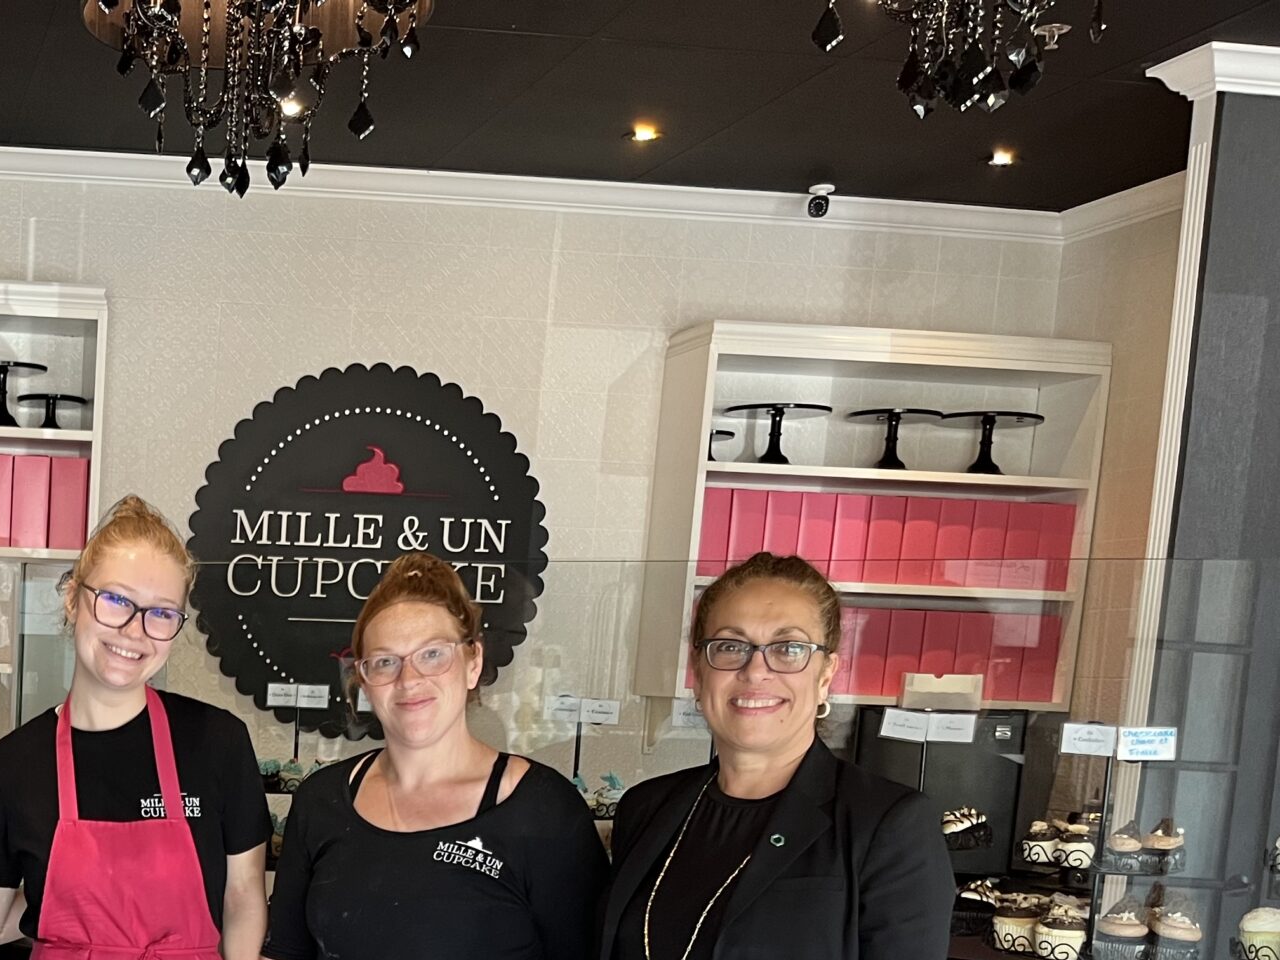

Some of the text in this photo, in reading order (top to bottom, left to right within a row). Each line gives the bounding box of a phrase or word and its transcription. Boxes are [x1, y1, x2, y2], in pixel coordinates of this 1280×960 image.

[230, 509, 512, 554] MILLE & UN
[184, 797, 200, 807] UN
[433, 850, 500, 879] CUPCAKE
[436, 841, 504, 870] MILLE & UN
